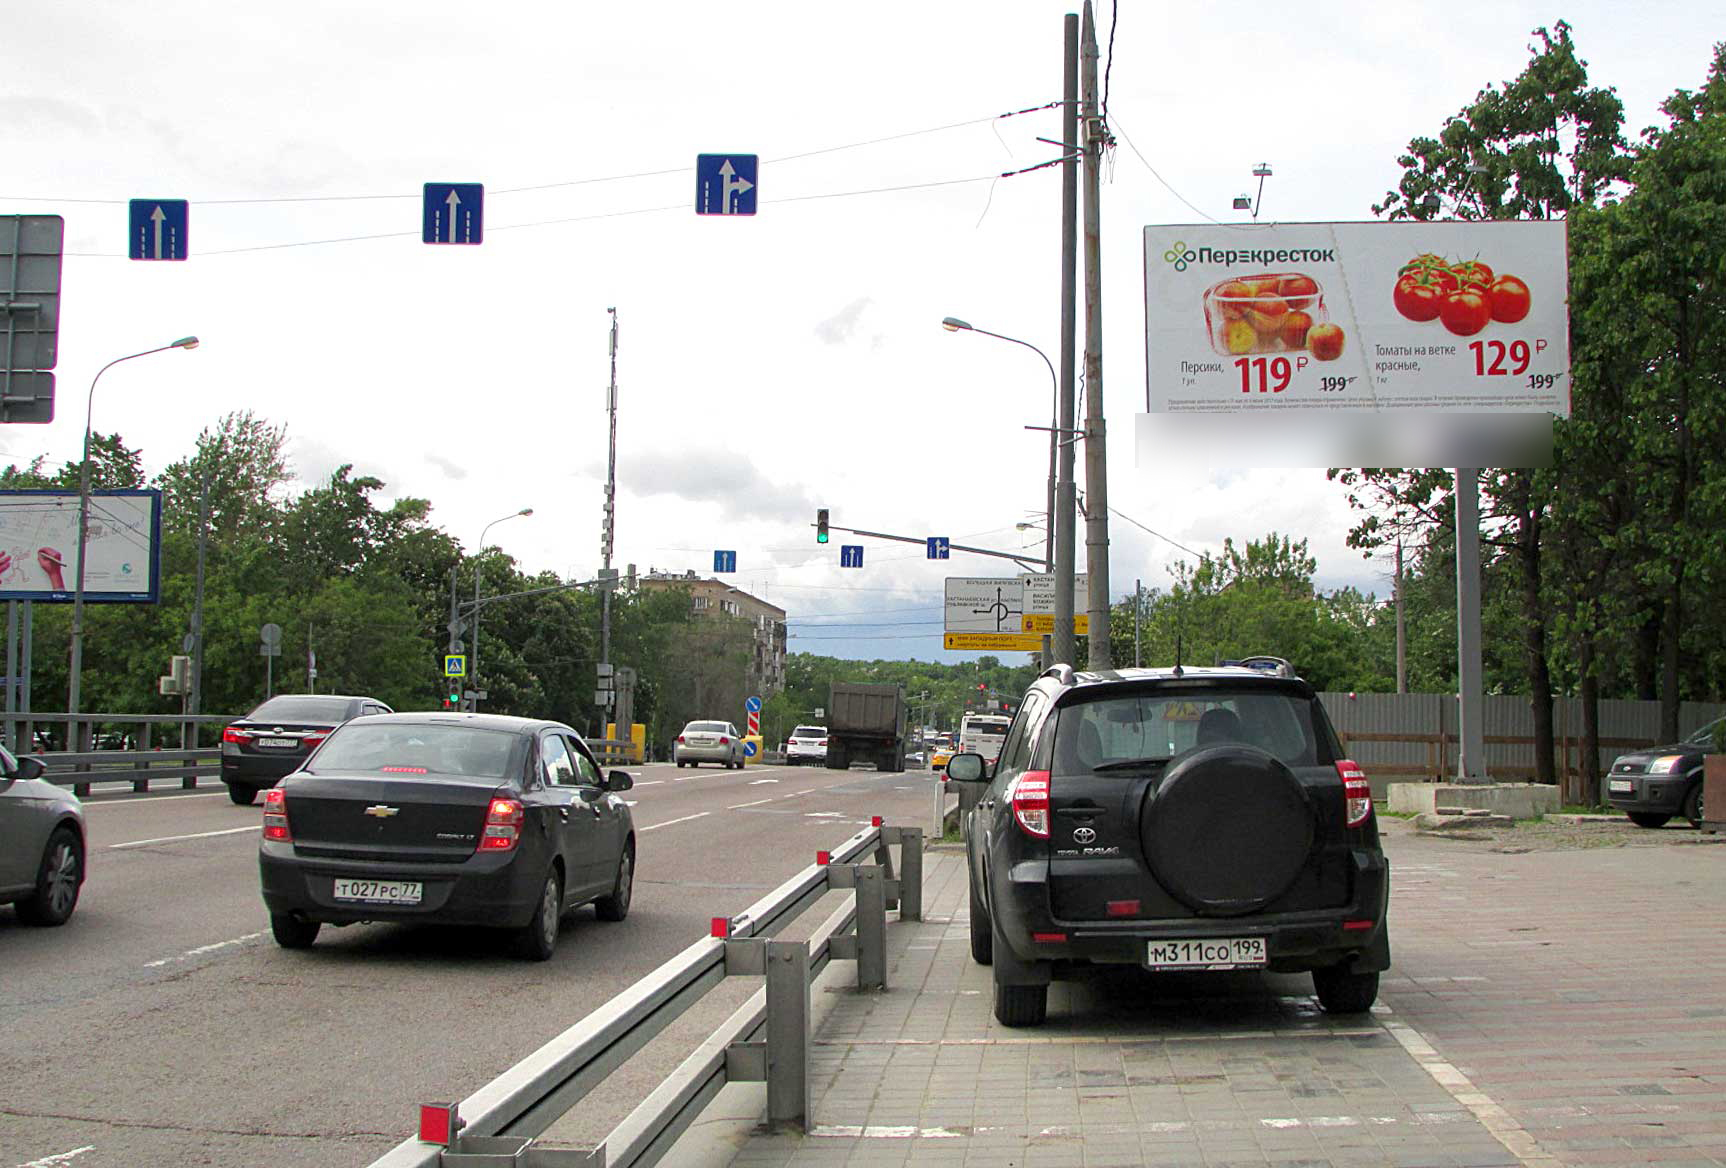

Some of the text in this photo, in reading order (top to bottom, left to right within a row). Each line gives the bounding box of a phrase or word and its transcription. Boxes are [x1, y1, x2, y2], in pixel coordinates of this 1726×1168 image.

[1198, 247, 1335, 268] Перекресток
[1376, 344, 1456, 356] Томаты на ветке
[1468, 339, 1531, 376] 129
[1180, 361, 1225, 376] Персики,
[1234, 356, 1292, 393] 119
[1375, 361, 1421, 373] красные,
[1320, 376, 1346, 392] 199
[402, 883, 418, 897] 77
[1233, 940, 1260, 955] 199
